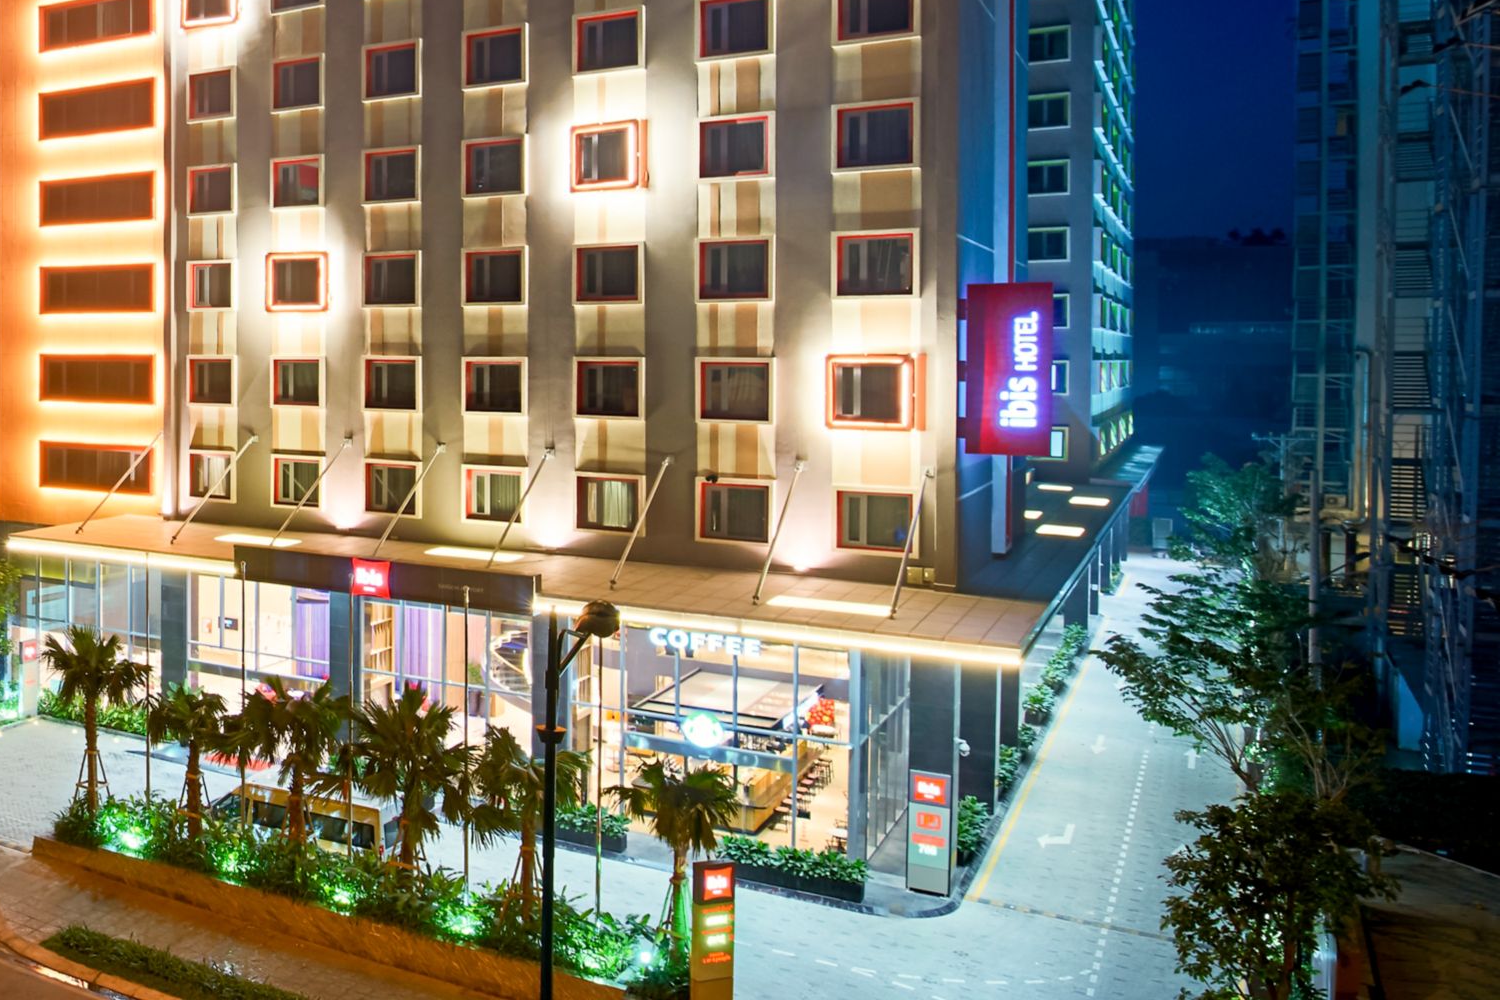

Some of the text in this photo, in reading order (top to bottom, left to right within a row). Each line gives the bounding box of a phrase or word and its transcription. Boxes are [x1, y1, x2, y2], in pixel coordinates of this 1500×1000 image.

[999, 310, 1039, 428] ibis HOTEL
[649, 627, 762, 658] COFFEE
